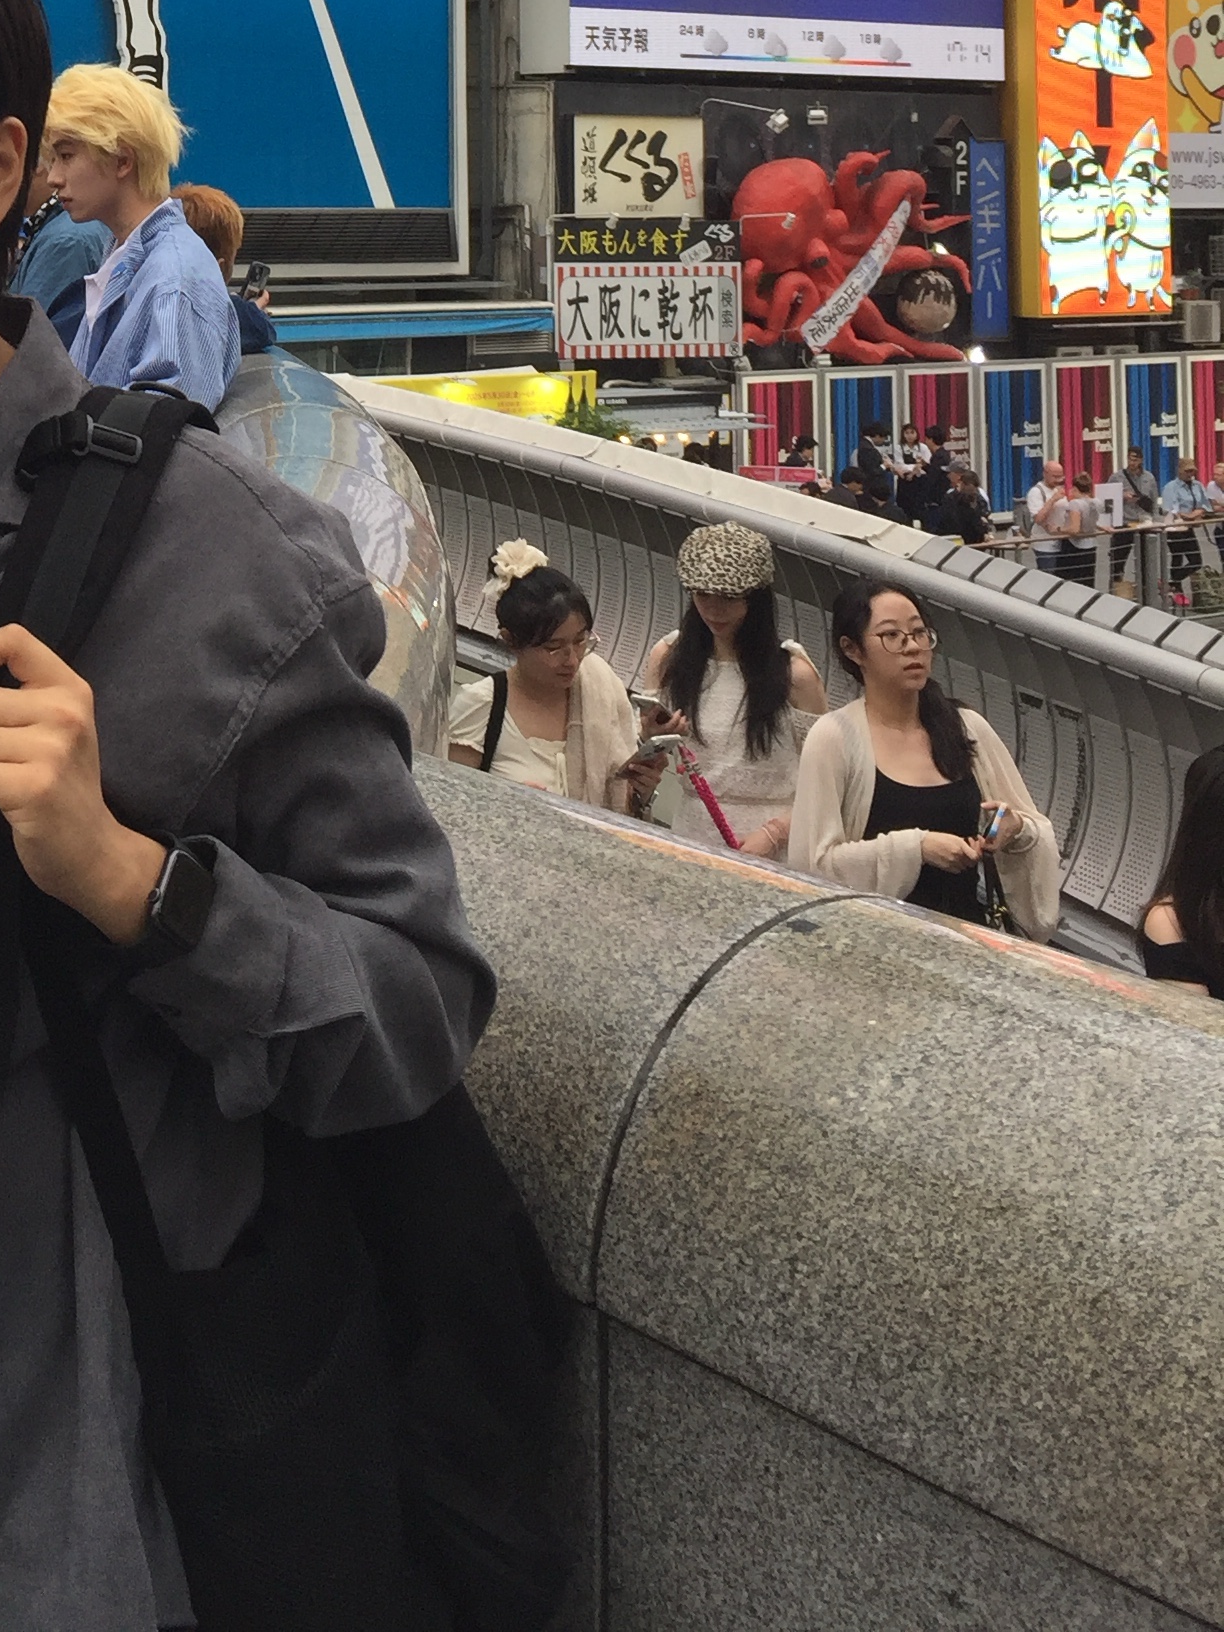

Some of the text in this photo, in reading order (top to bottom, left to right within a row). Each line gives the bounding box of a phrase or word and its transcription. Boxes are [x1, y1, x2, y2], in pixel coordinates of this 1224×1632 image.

[585, 25, 649, 54] 天気予報
[598, 128, 678, 203] くくる
[557, 227, 688, 256] 大阪もんを食す
[714, 245, 736, 261] 2F
[567, 279, 714, 342] 大阪に乾杯
